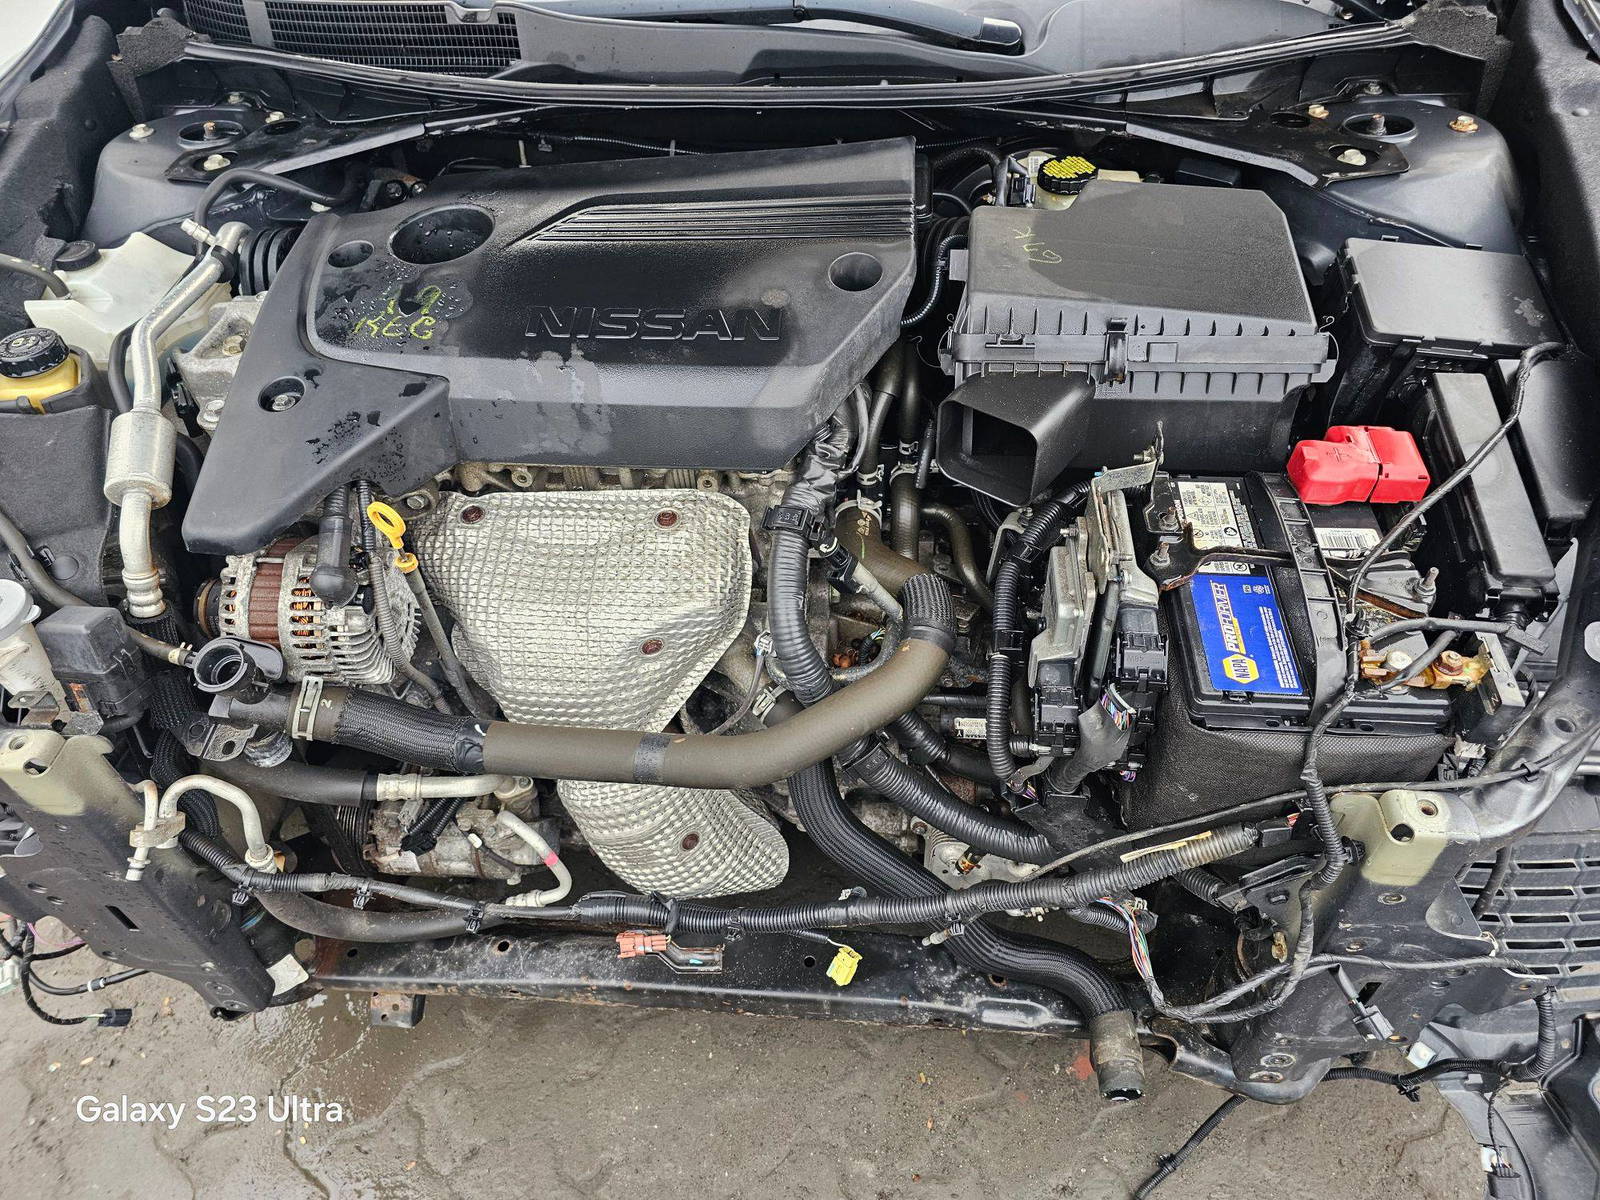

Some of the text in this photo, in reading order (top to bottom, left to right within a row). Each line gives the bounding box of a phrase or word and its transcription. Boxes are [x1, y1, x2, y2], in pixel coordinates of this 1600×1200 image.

[525, 305, 783, 341] NISSAN
[1211, 582, 1242, 653] PROFORMER
[1231, 658, 1252, 679] NAPA
